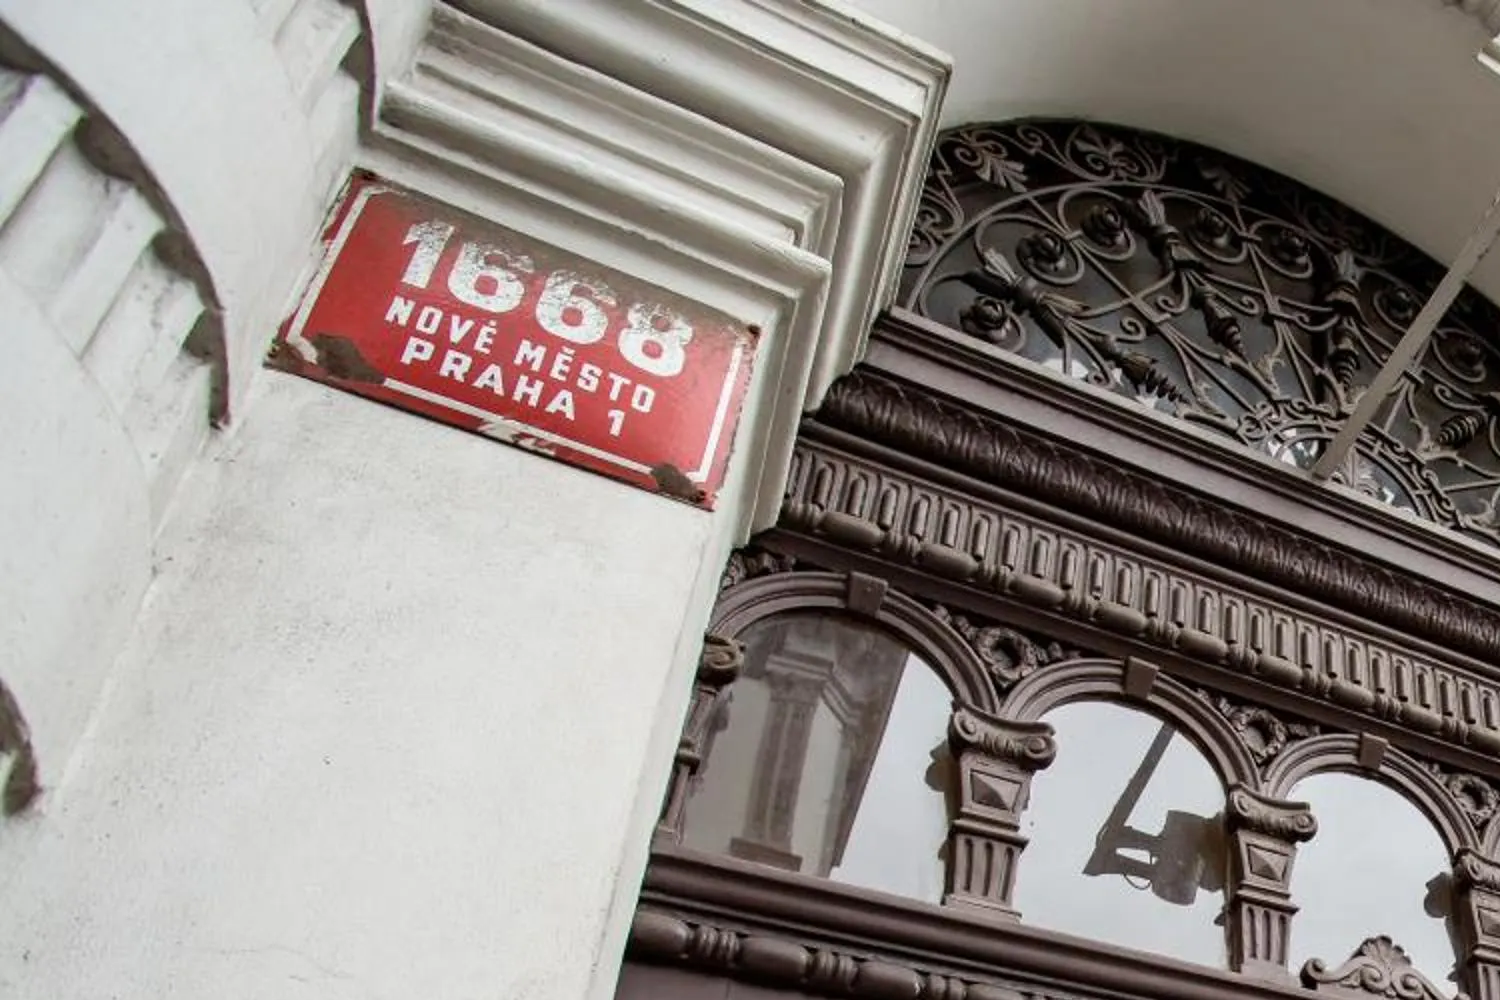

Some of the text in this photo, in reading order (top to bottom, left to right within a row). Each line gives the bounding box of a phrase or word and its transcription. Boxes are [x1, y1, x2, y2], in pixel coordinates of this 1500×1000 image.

[385, 296, 656, 413] NOVÉ MĚSTO
[402, 220, 692, 377] 1668
[400, 336, 625, 437] PRAHA 1
